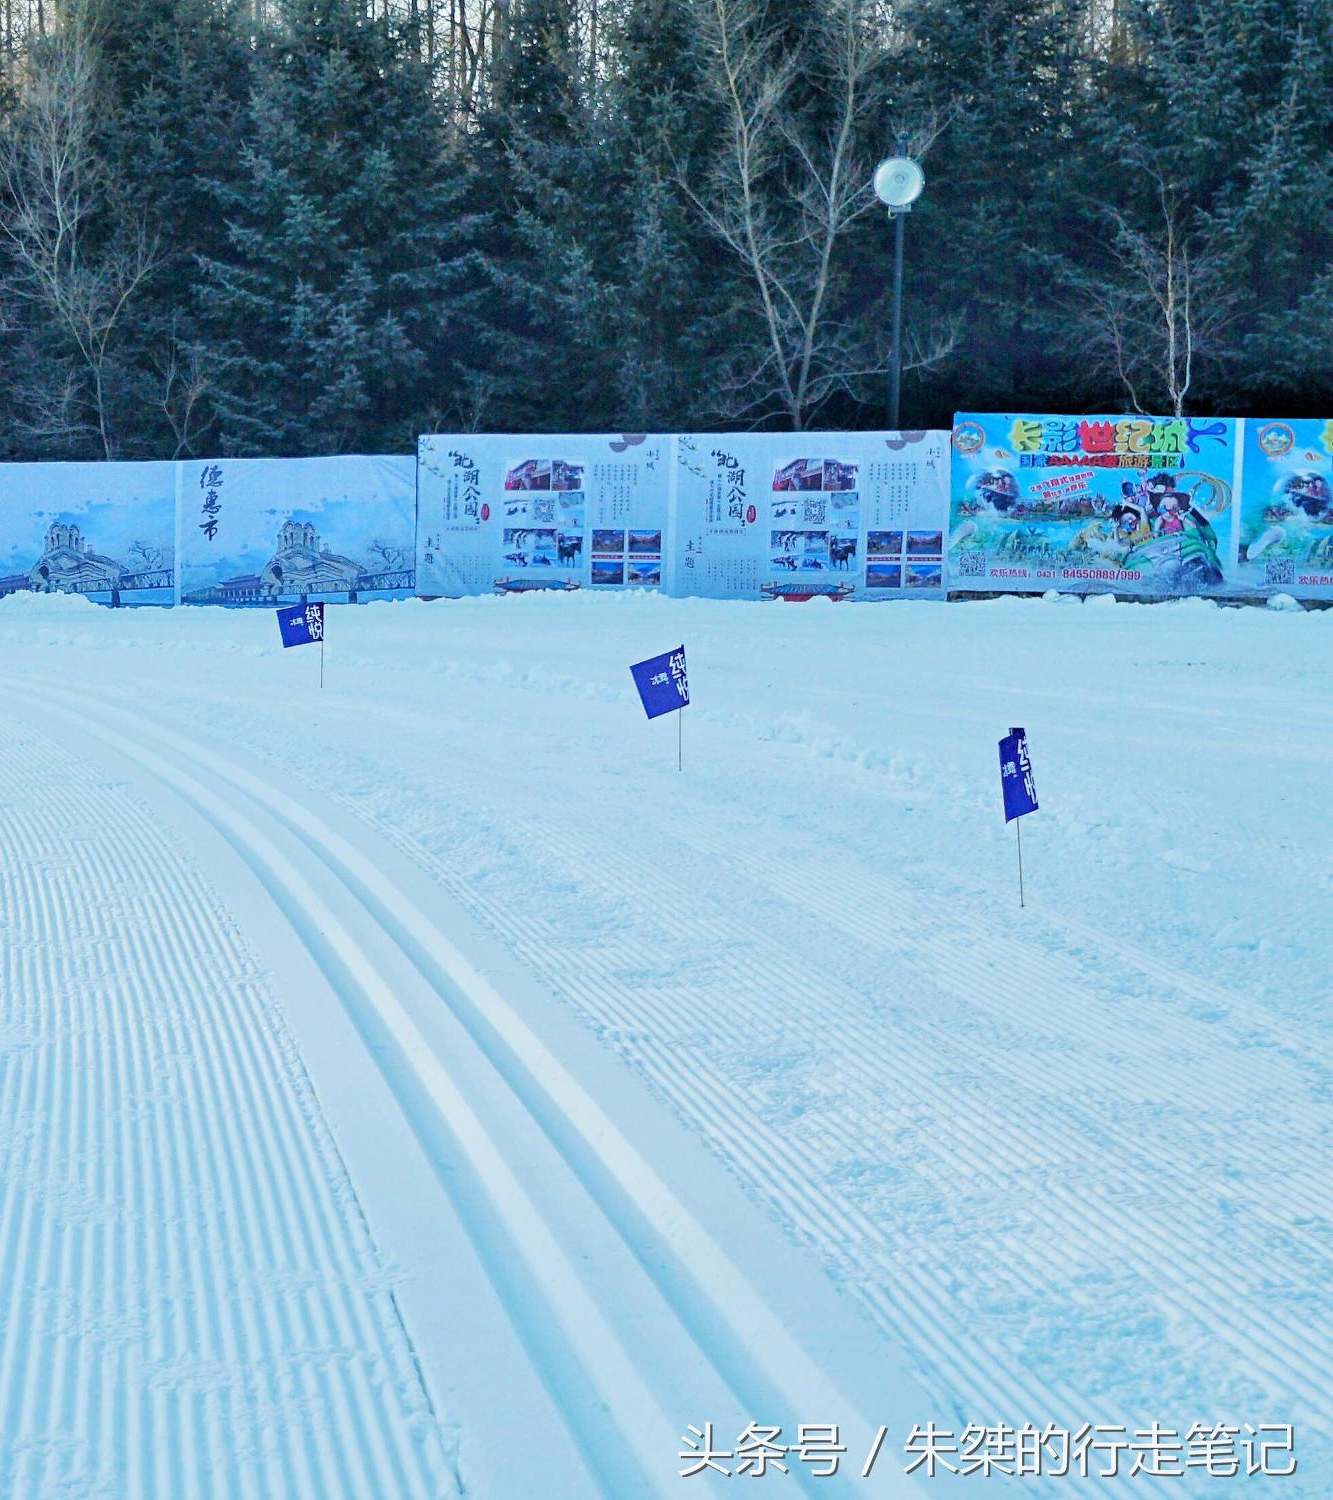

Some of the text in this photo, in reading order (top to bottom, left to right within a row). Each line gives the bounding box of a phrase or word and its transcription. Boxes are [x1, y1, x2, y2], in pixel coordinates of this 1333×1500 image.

[1012, 419, 1189, 453] 长影世纪城
[199, 465, 225, 542] 德惠市
[305, 605, 324, 640] 纯悦
